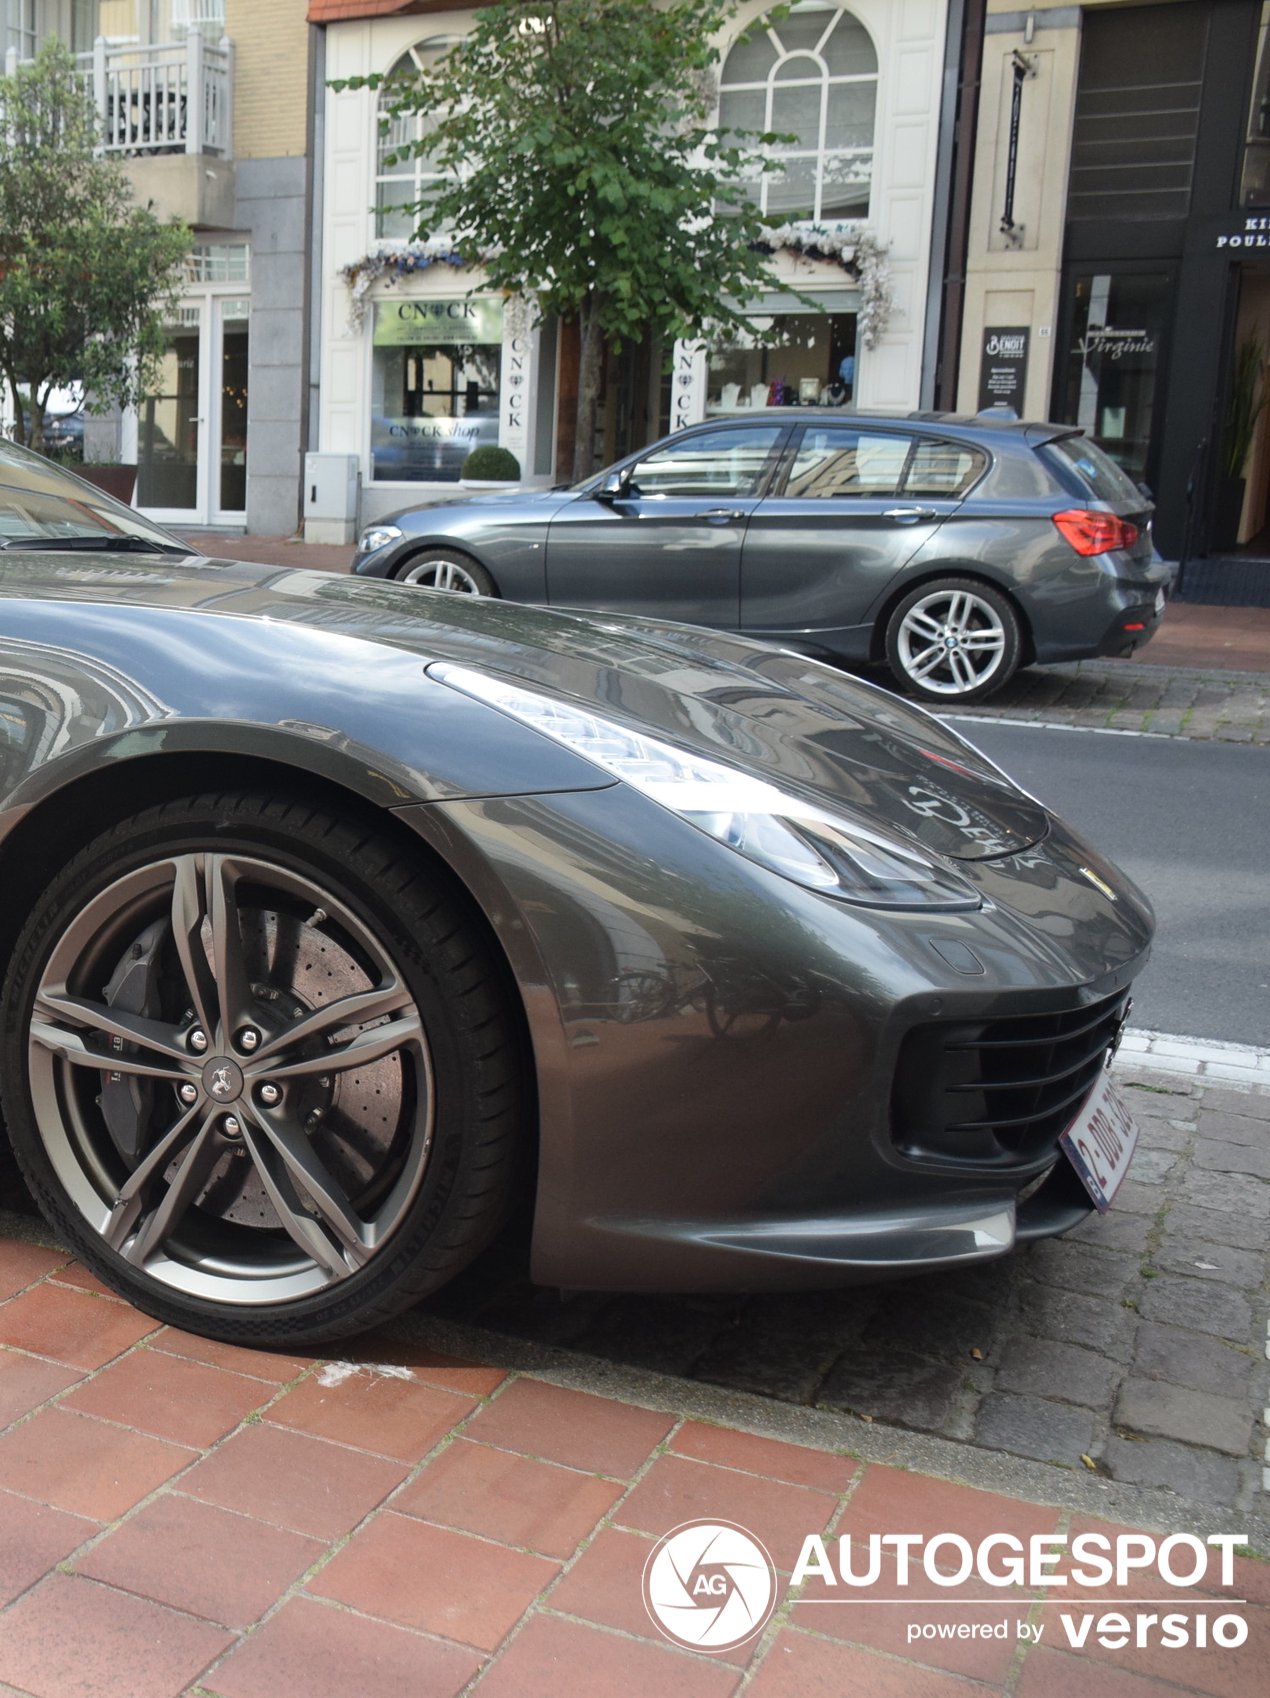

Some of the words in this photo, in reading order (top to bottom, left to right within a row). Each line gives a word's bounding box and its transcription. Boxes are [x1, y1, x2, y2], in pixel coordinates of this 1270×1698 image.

[1245, 217, 1270, 230] KI
[1216, 234, 1270, 248] POUL
[1078, 337, 1154, 360] Virginie
[447, 422, 480, 441] shop
[10, 901, 59, 1003] MICHELIN
[1086, 1175, 1102, 1200] B
